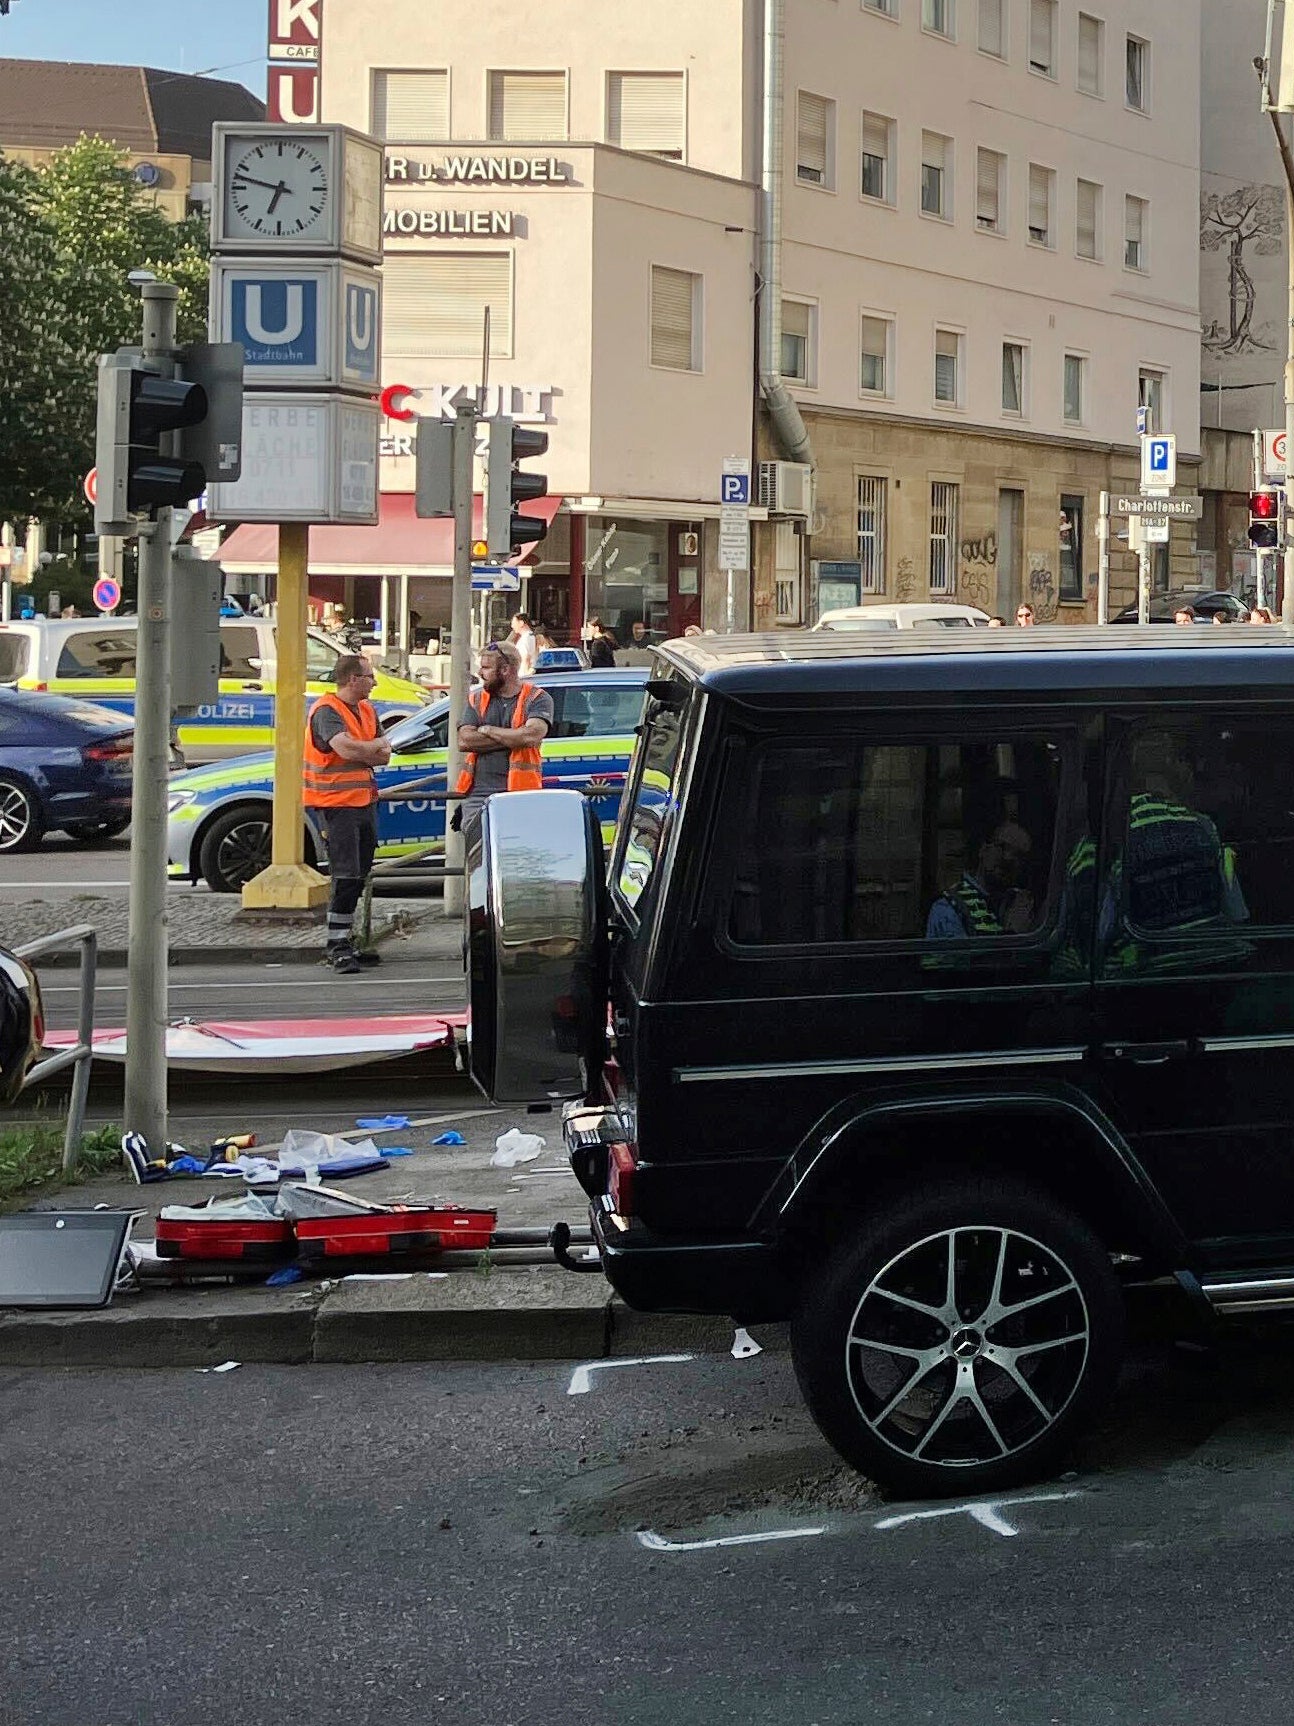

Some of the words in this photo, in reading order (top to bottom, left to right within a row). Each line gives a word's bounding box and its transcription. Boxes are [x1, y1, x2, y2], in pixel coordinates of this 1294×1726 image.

[385, 156, 408, 179] R
[444, 157, 566, 180] WANDEL
[245, 285, 304, 345] U
[350, 289, 371, 350] U
[245, 345, 303, 361] Stadtbahn
[1154, 444, 1165, 468] P
[725, 477, 741, 500] P
[1118, 498, 1194, 513] Charlottenstr.
[198, 704, 254, 719] OLIZEI
